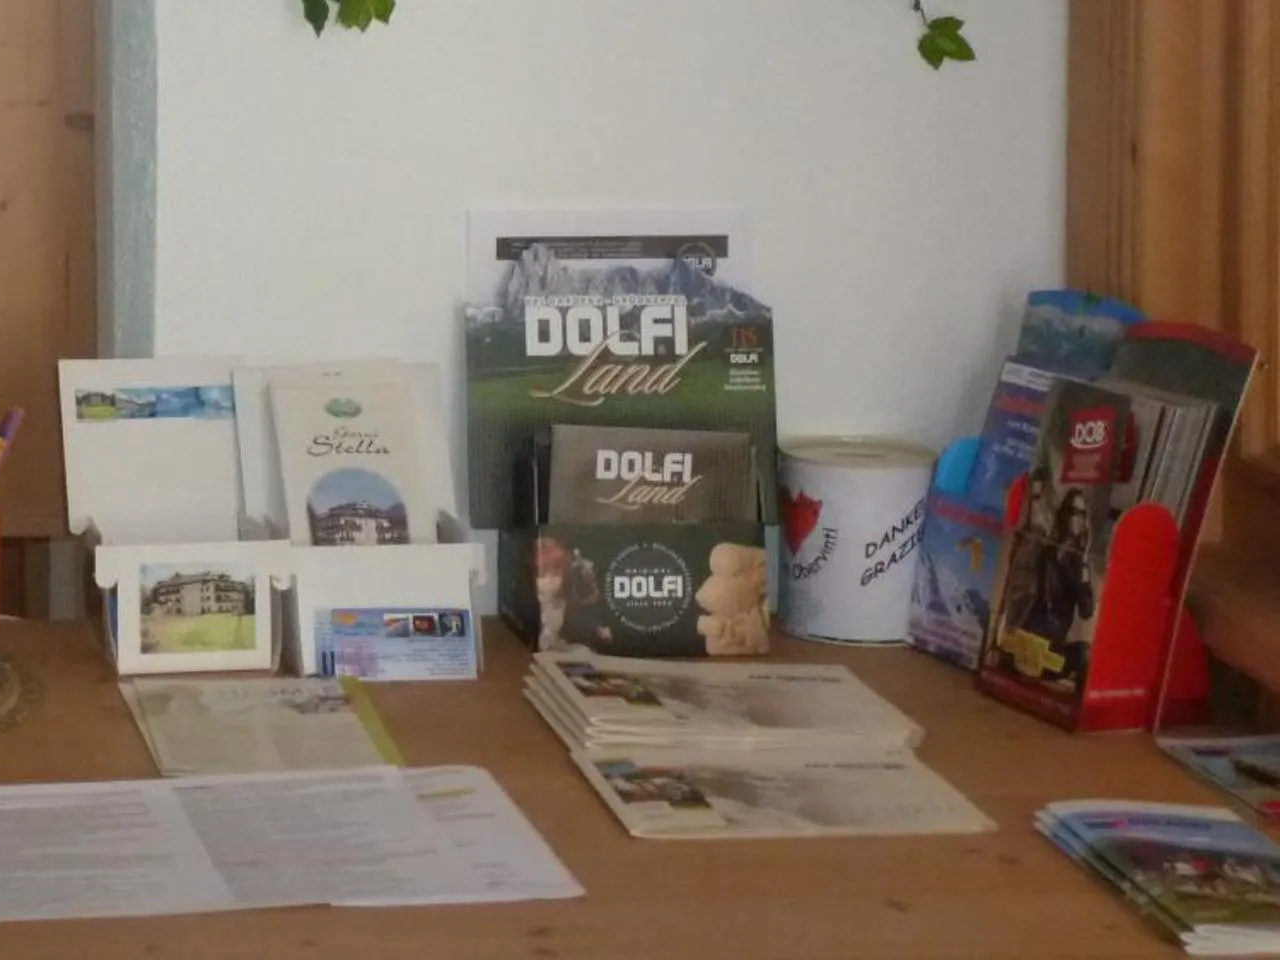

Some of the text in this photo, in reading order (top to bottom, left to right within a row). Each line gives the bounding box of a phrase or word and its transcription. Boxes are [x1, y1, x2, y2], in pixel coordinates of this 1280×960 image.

[524, 304, 689, 357] DOLFI
[529, 329, 709, 407] Land
[306, 435, 391, 457] Stella
[595, 449, 693, 483] DOLFI
[596, 474, 702, 510] Land
[613, 575, 684, 599] DOLFI
